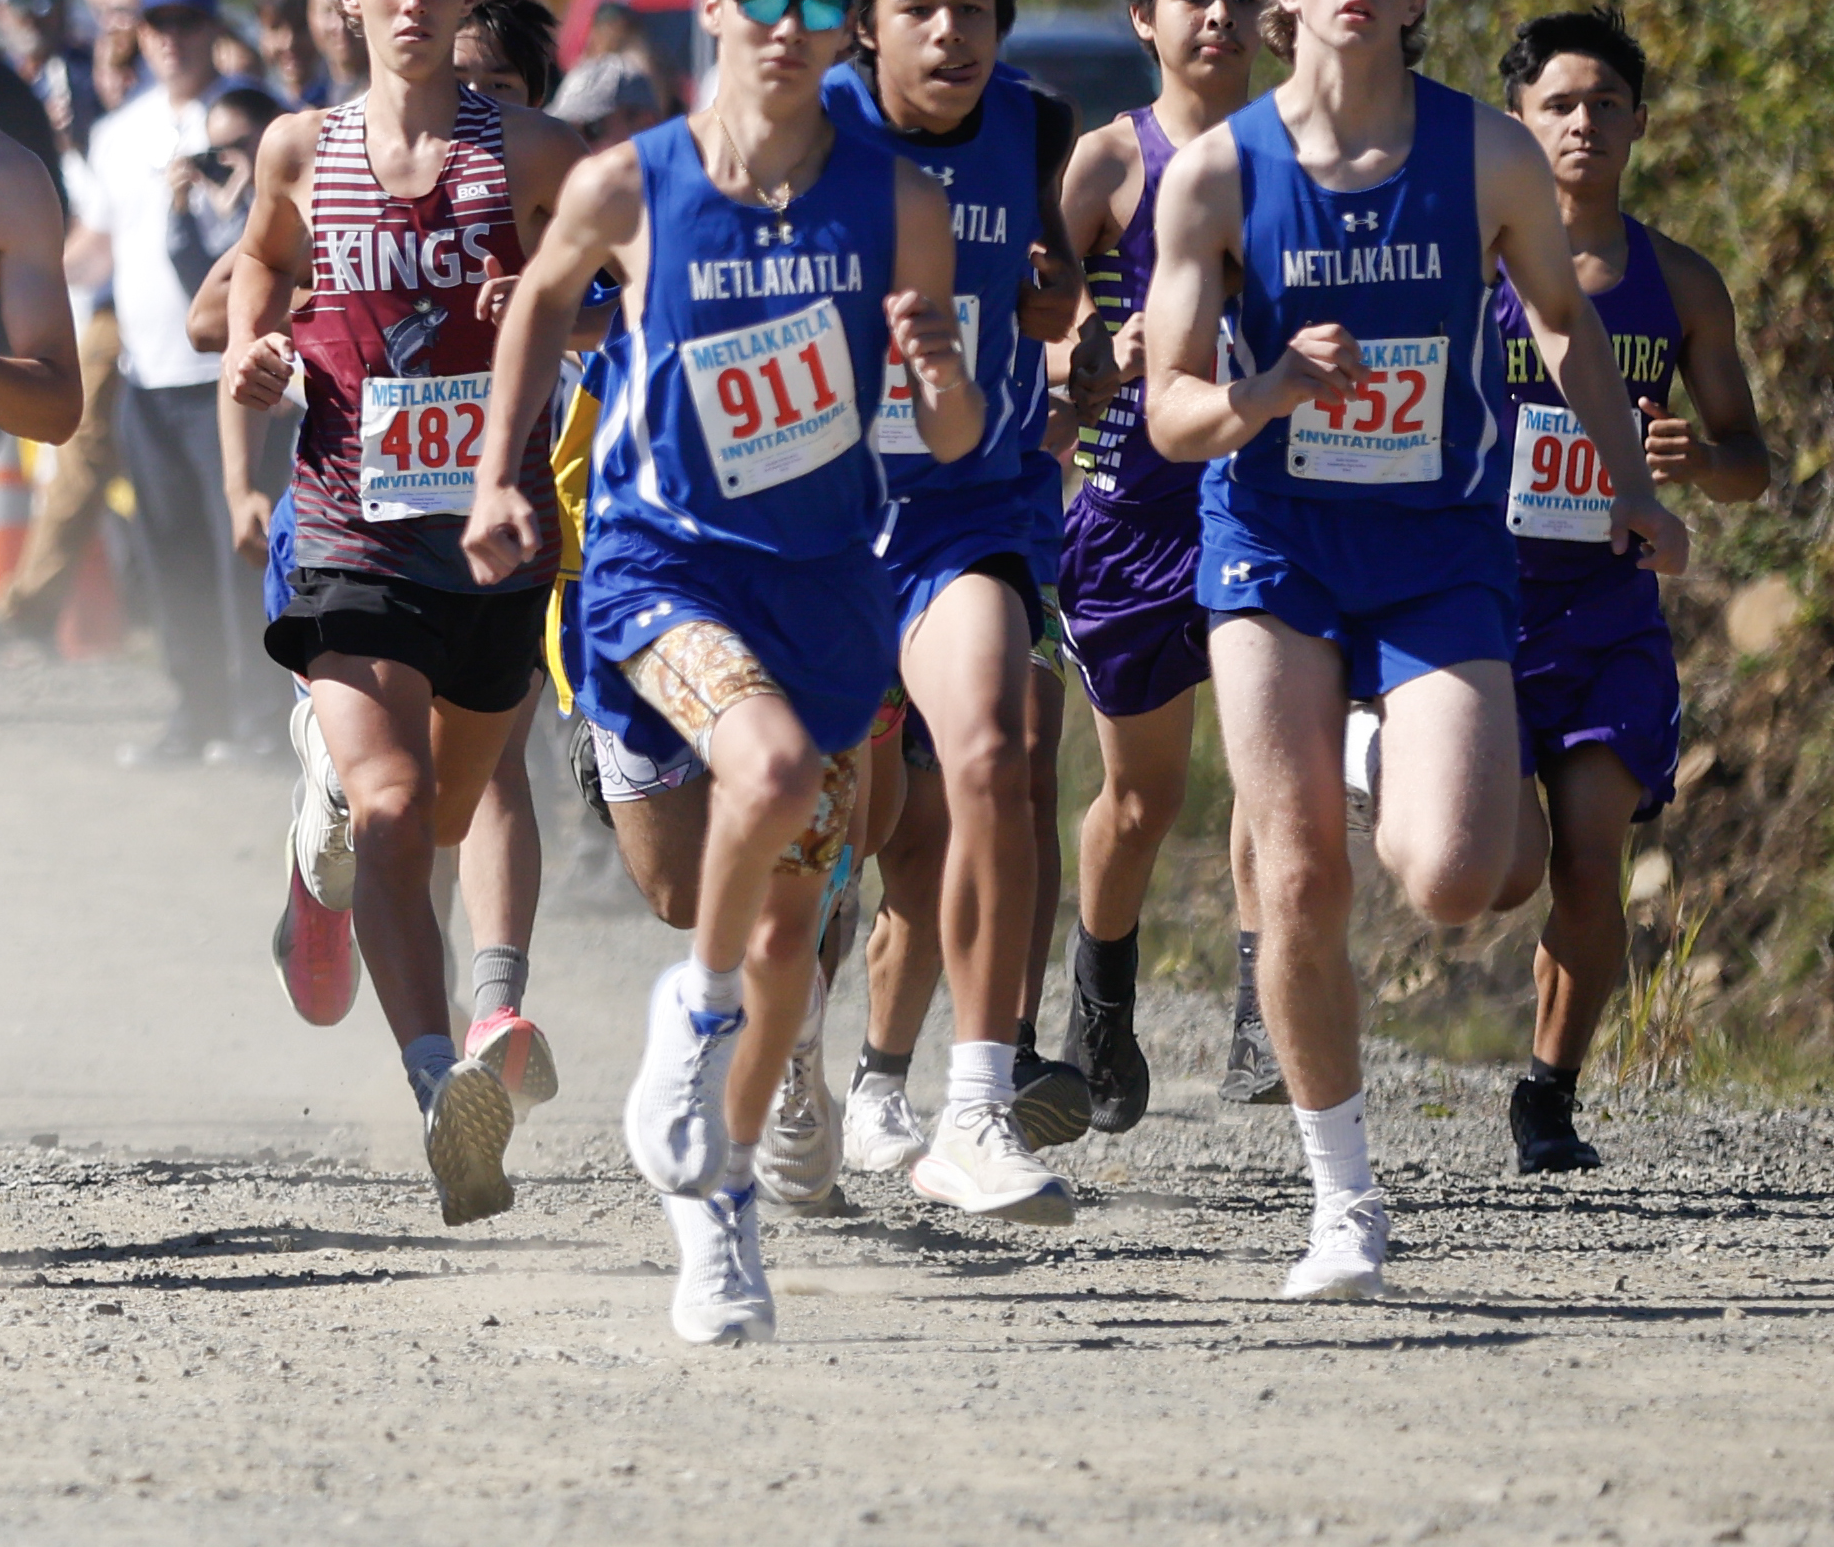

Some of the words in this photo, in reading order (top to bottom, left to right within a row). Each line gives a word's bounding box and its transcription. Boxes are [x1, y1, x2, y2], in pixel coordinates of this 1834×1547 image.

[456, 184, 490, 200] BOA
[326, 222, 490, 291] KINGS
[687, 253, 863, 301] METLAKATLA
[1283, 243, 1442, 288] METLAKATLA
[693, 309, 832, 372] METLAKATLA
[1359, 343, 1440, 368] AKATLA
[1505, 333, 1669, 384] HYURG
[716, 341, 838, 441] 911
[380, 401, 485, 472] 482
[719, 401, 849, 463] INVITATIONAL
[1298, 428, 1431, 451] INVITATIONAL
